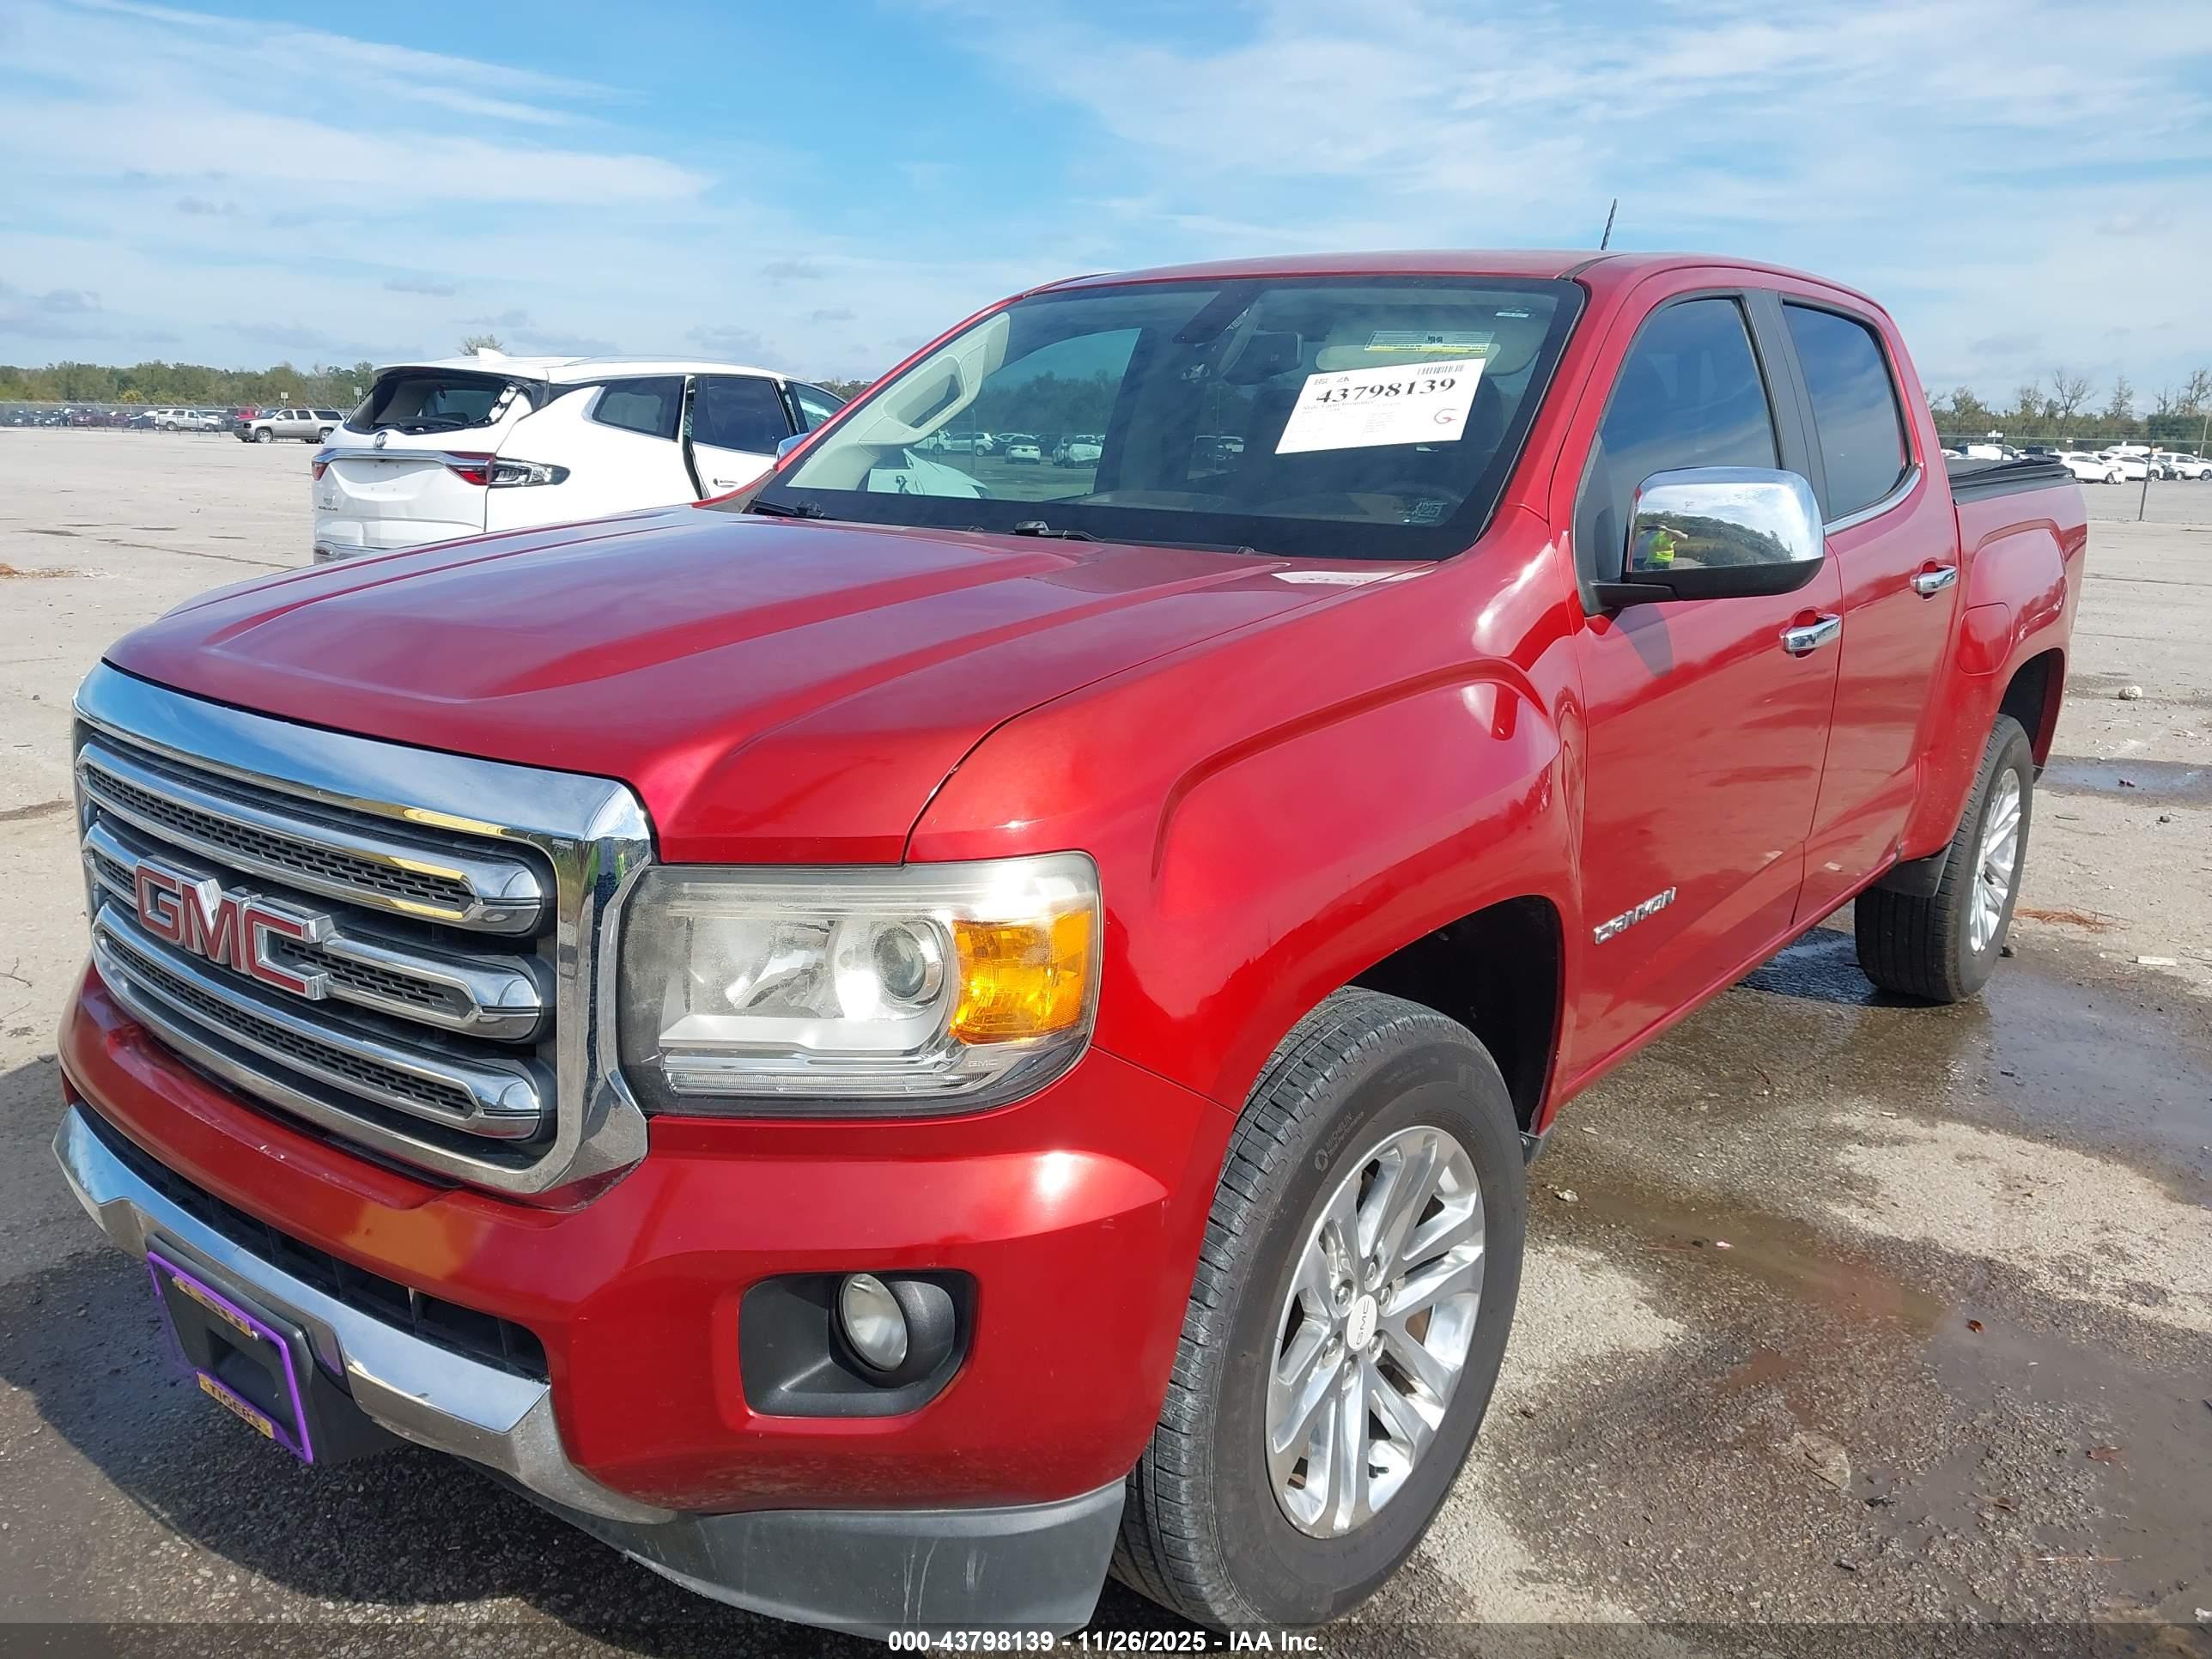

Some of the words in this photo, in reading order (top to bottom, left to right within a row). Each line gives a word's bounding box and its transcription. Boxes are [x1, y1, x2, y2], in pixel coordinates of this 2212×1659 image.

[1316, 378, 1456, 404] 43798139
[1433, 408, 1457, 425] G
[135, 857, 332, 1001] GMC
[1593, 886, 1677, 945] CANYON
[968, 1059, 999, 1067] GMC
[1356, 1300, 1370, 1345] GMC
[210, 1384, 261, 1428] TIGERS
